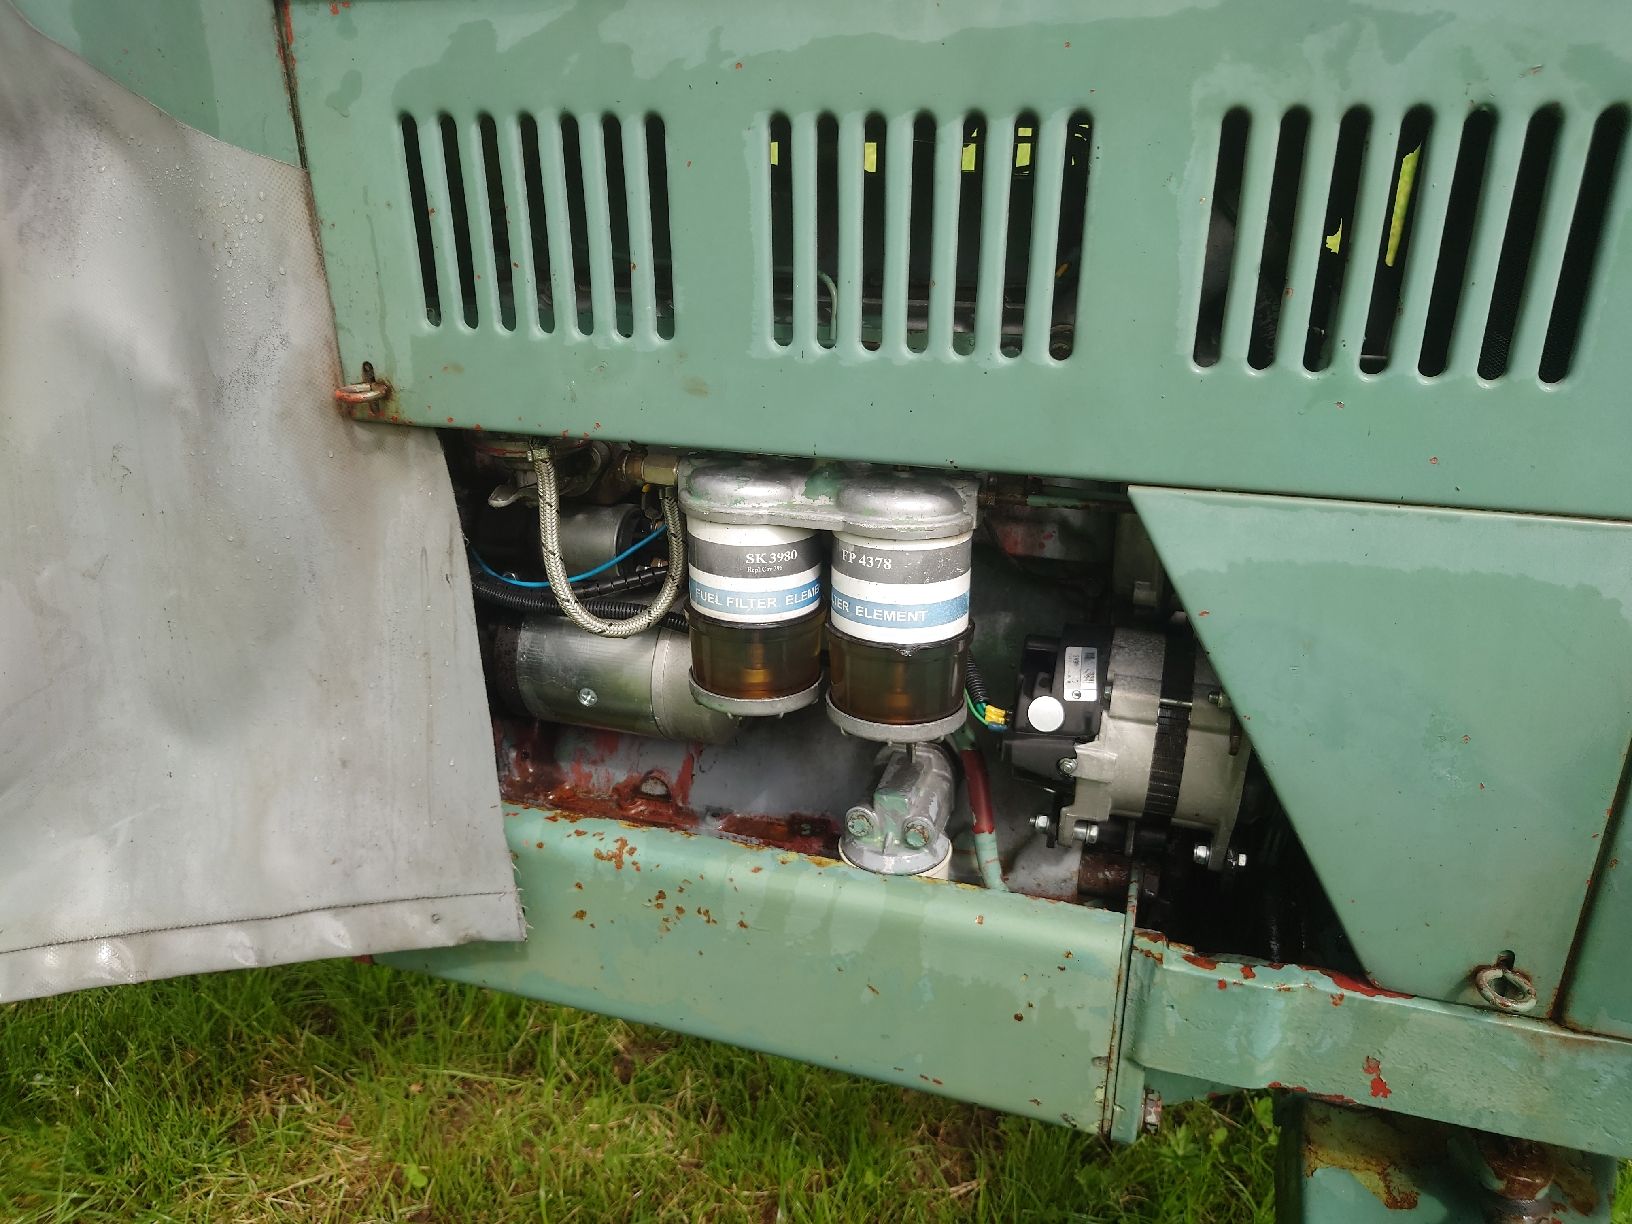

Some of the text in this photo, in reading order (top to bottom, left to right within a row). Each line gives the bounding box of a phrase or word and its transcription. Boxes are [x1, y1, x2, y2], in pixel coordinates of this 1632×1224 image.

[746, 550, 798, 564] SK 3980
[842, 548, 892, 570] FP 4378
[695, 588, 722, 606] FUEL
[726, 597, 776, 609] FILTER
[856, 606, 928, 622] ELEMENT
